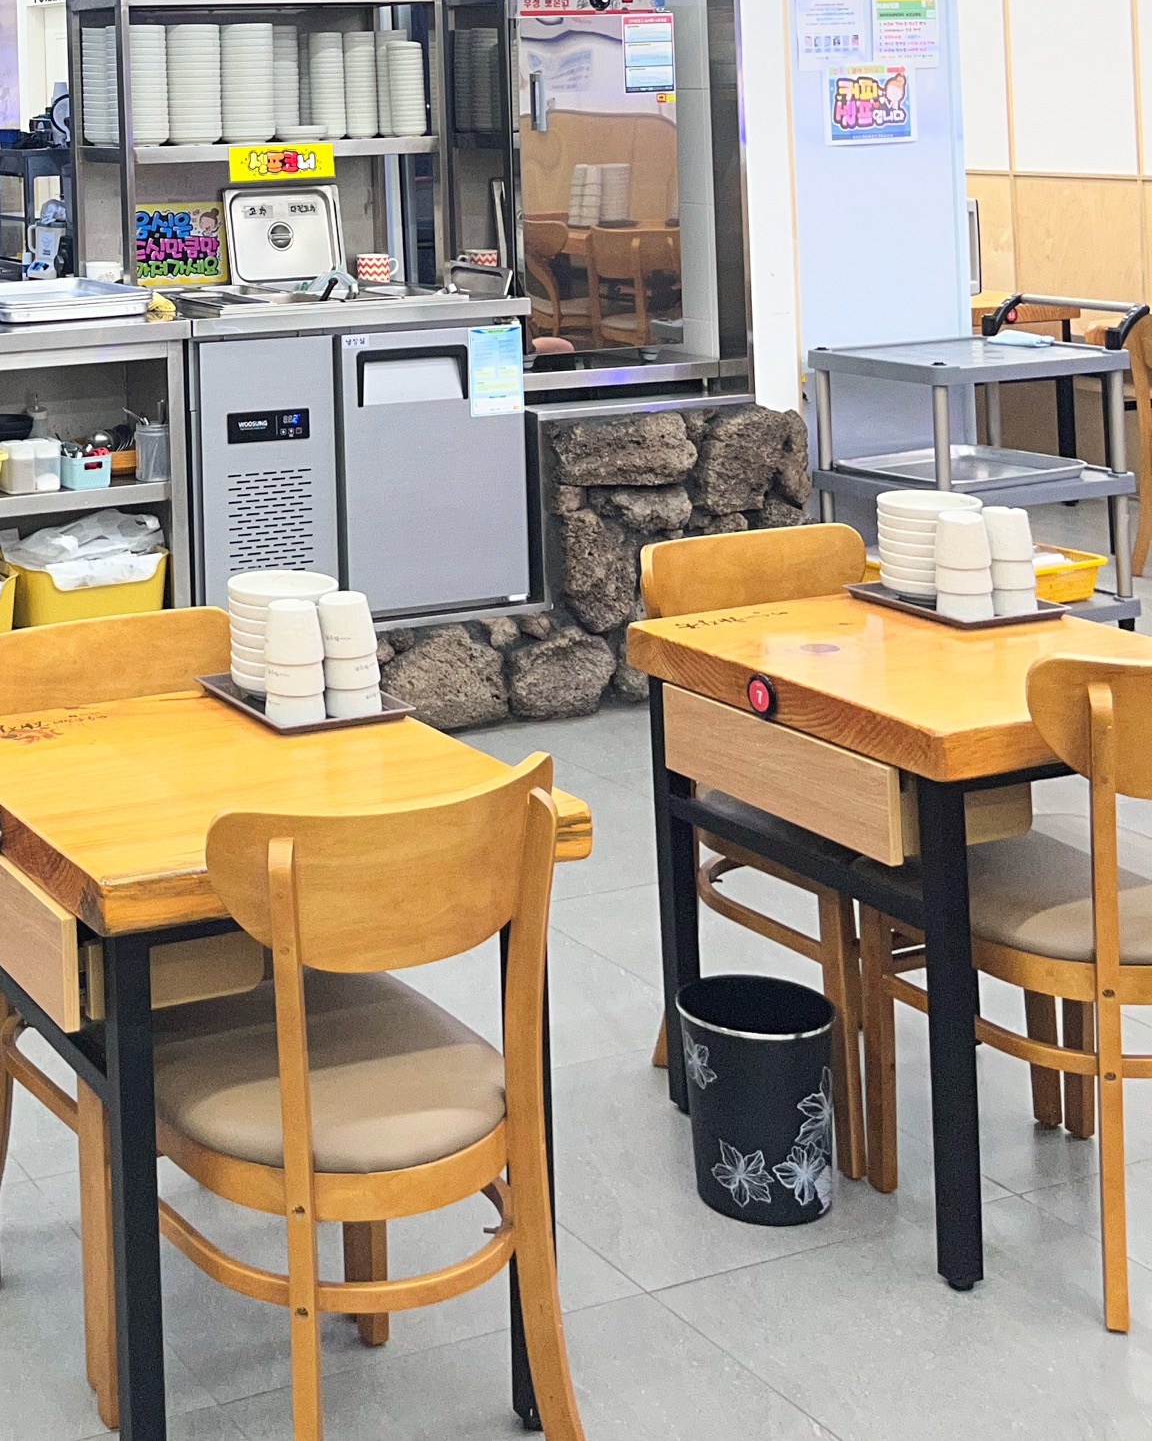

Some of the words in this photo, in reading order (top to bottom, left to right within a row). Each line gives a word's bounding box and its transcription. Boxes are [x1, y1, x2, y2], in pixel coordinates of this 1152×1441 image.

[838, 79, 878, 100] 커피
[136, 211, 193, 238] 음식은
[137, 256, 219, 278] 가져가세요
[238, 420, 268, 428] WOOSUNG
[756, 689, 762, 704] 7
